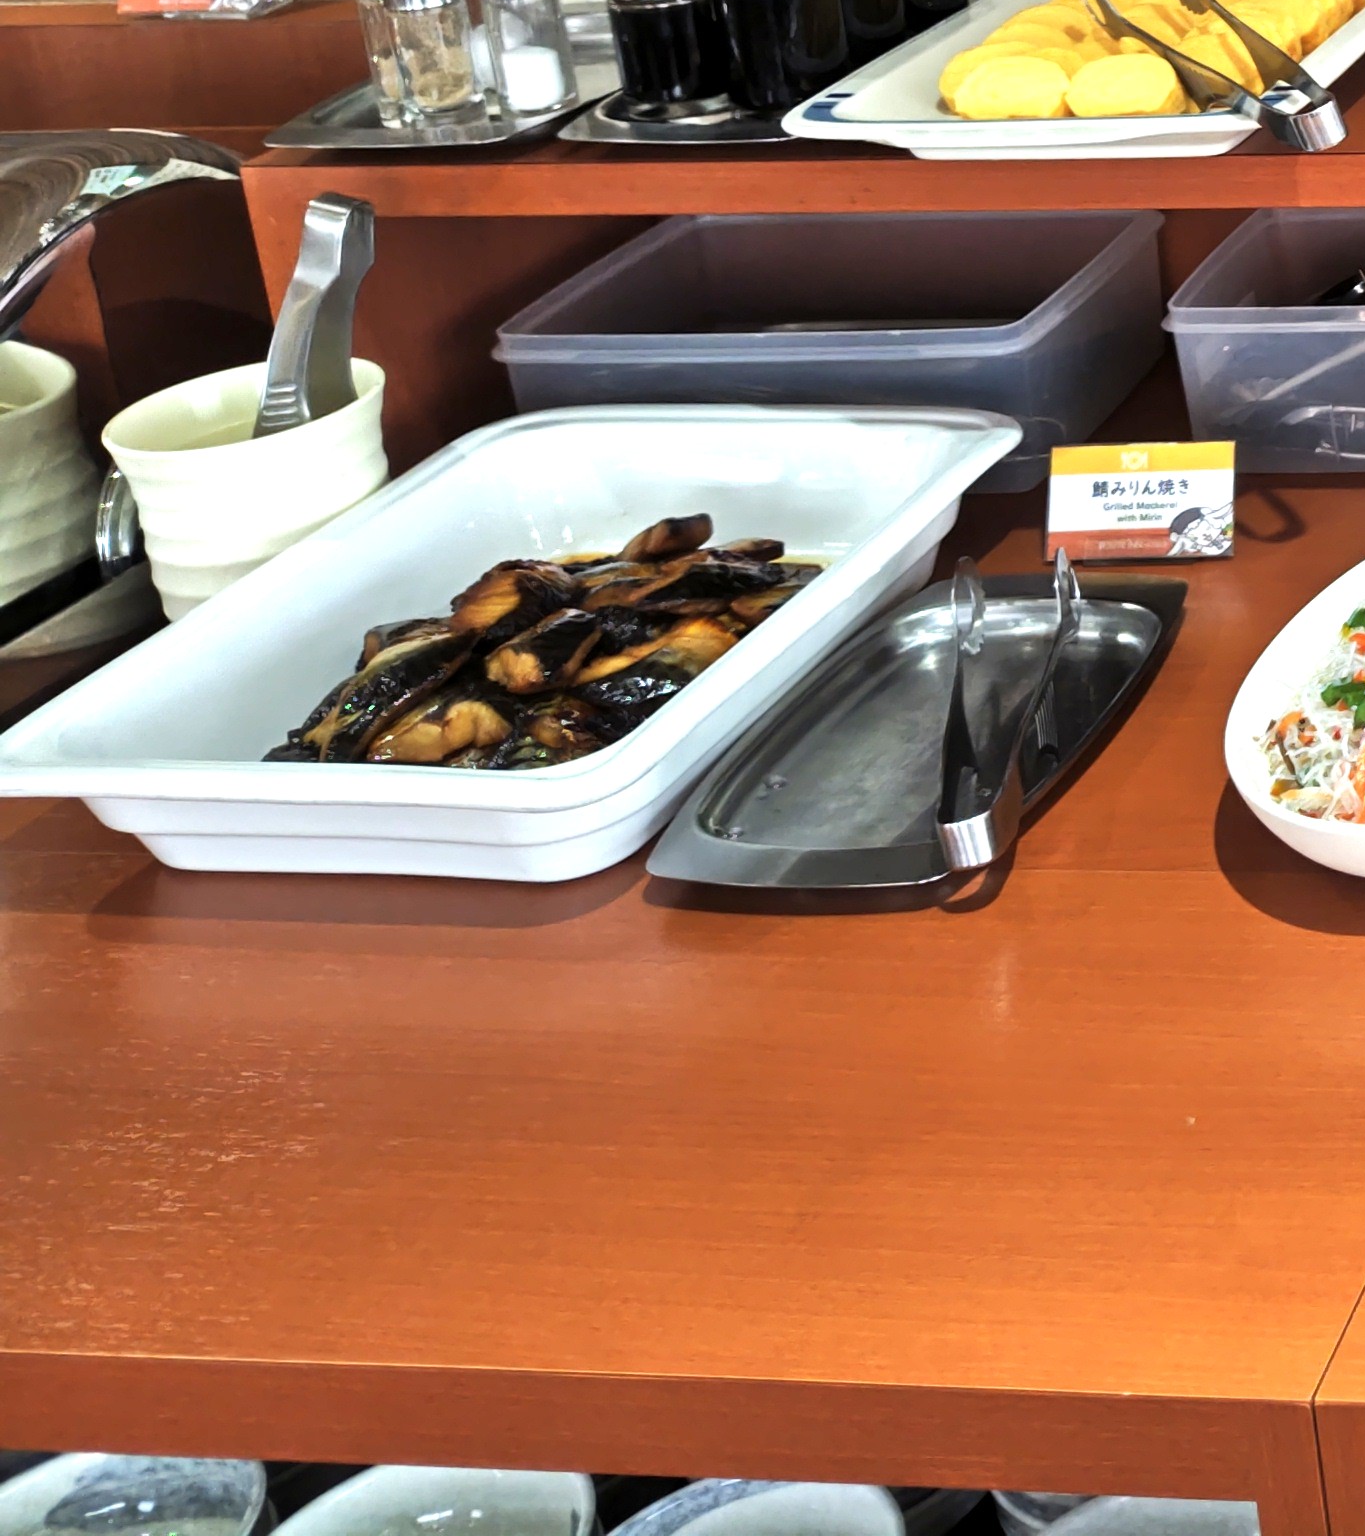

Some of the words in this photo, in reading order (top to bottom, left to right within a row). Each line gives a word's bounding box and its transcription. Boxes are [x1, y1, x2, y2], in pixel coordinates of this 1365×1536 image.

[1092, 479, 1190, 498] 鯖みりん焼き
